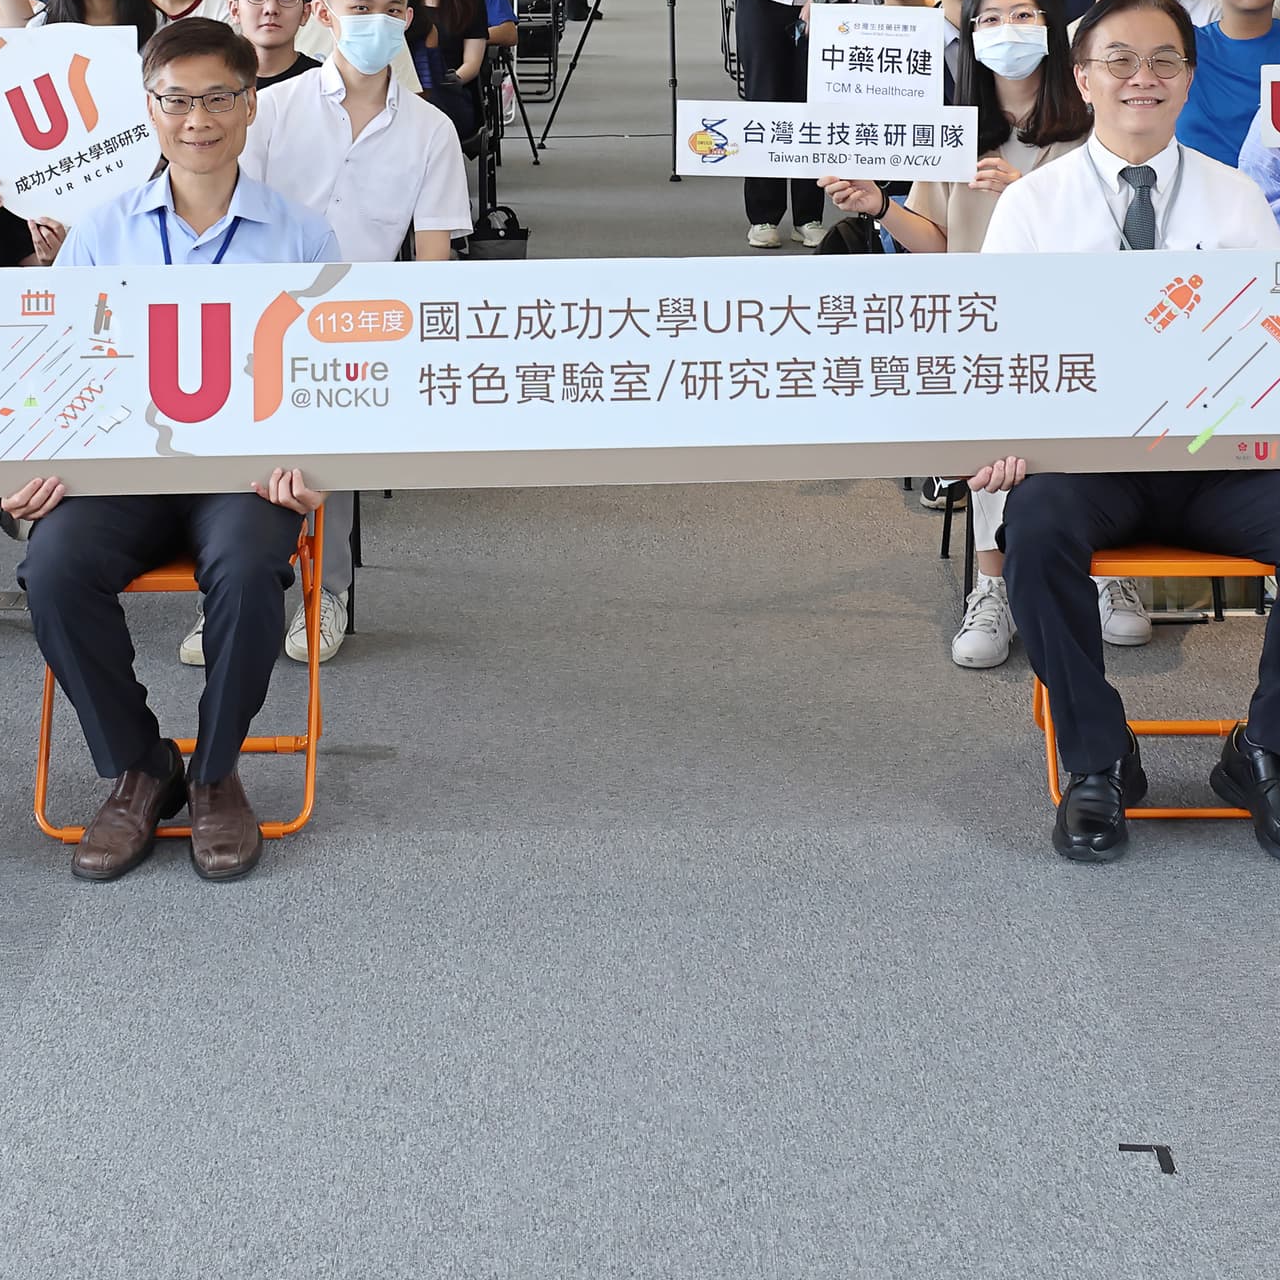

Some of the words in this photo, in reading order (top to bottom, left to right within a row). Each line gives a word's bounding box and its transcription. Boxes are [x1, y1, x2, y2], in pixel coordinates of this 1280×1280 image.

[821, 43, 933, 76] 中藥保健
[825, 81, 852, 94] TCM
[854, 83, 863, 94] &
[866, 84, 925, 98] Healthcare
[742, 120, 965, 149] 台灣生技藥研團隊
[14, 123, 150, 195] 成功大學大學部研究
[768, 151, 809, 164] Taiwan
[854, 153, 886, 165] Team
[54, 182, 75, 196] UR
[83, 159, 125, 184] NCKU
[315, 309, 405, 334] 113年度
[419, 293, 999, 343] 國立成功大學UR大學部研究
[290, 356, 389, 383] Future
[419, 353, 1098, 407] 特色實驗室/研究室導覽暨海報展
[291, 387, 389, 408] @NCKU
